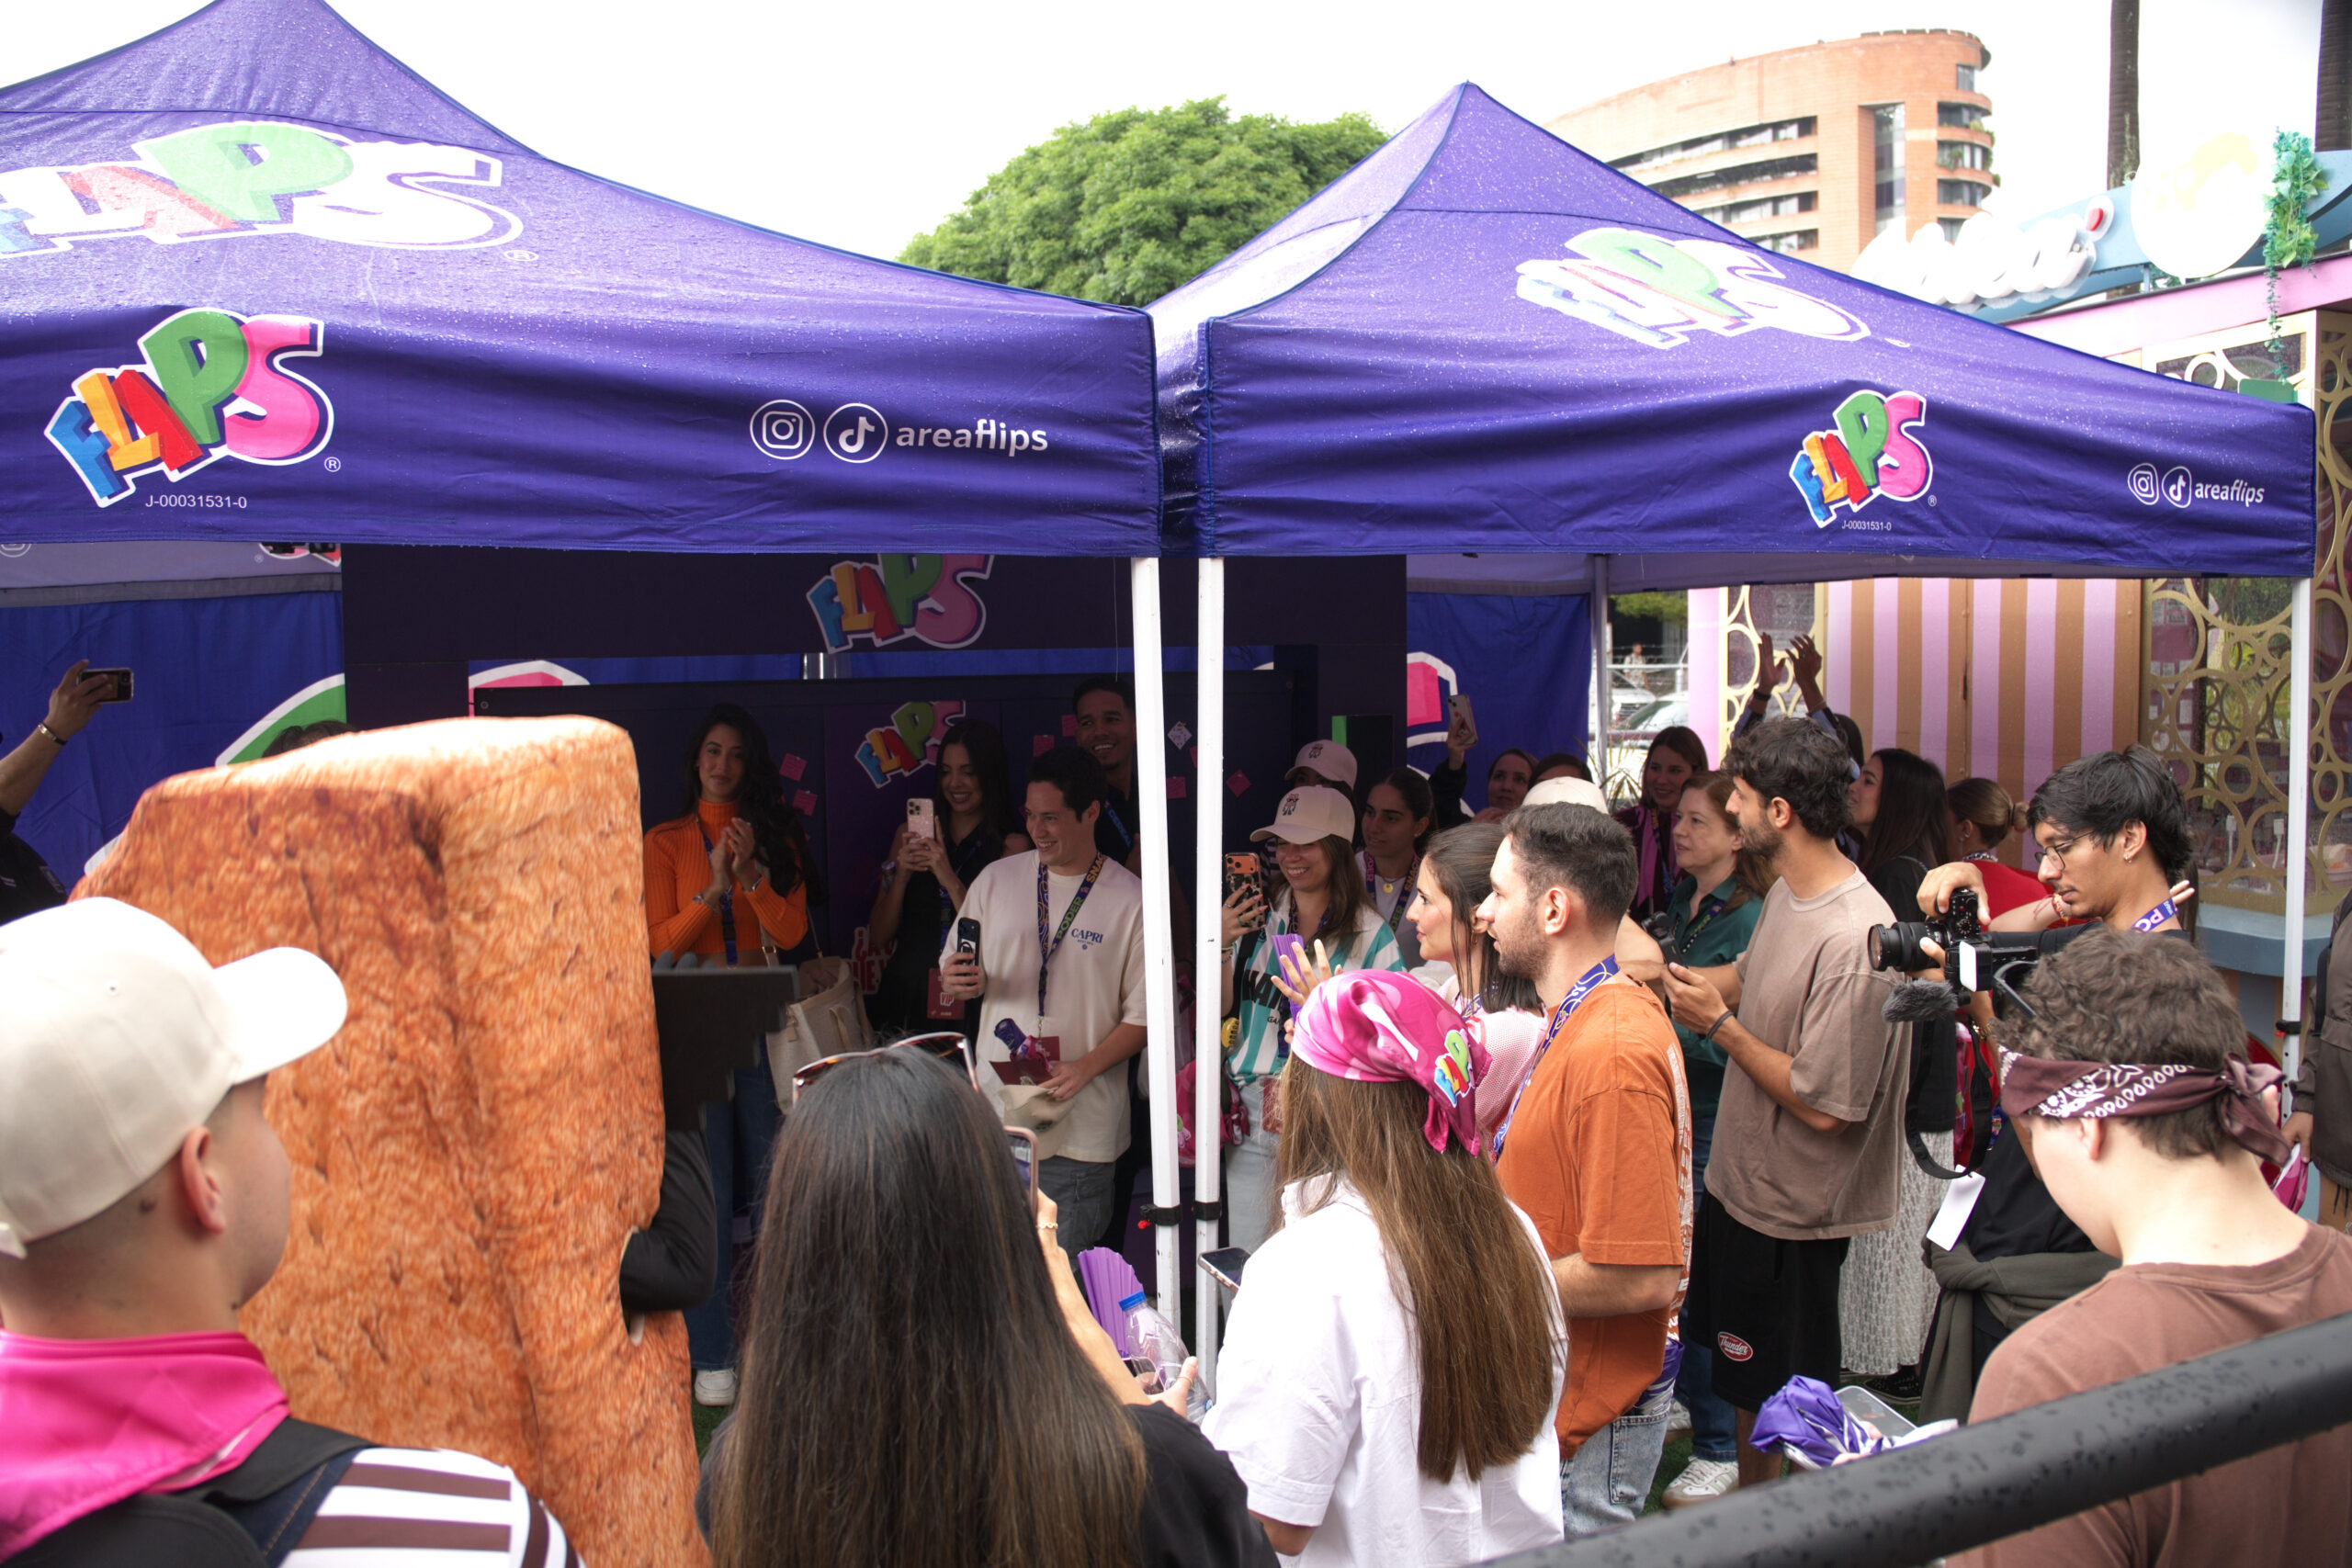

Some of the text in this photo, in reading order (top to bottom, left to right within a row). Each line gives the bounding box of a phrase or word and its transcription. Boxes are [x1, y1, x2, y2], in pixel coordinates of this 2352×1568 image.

[44, 307, 334, 508] FLIPS
[896, 419, 1048, 457] areaflips
[1788, 389, 1933, 528] FLIPS
[145, 494, 247, 508] J-00031531-0
[2195, 479, 2265, 507] areaflips
[1841, 520, 1893, 531] J-00031531-0
[1071, 928, 1103, 943] CAPRI
[939, 991, 956, 1007] VIP
